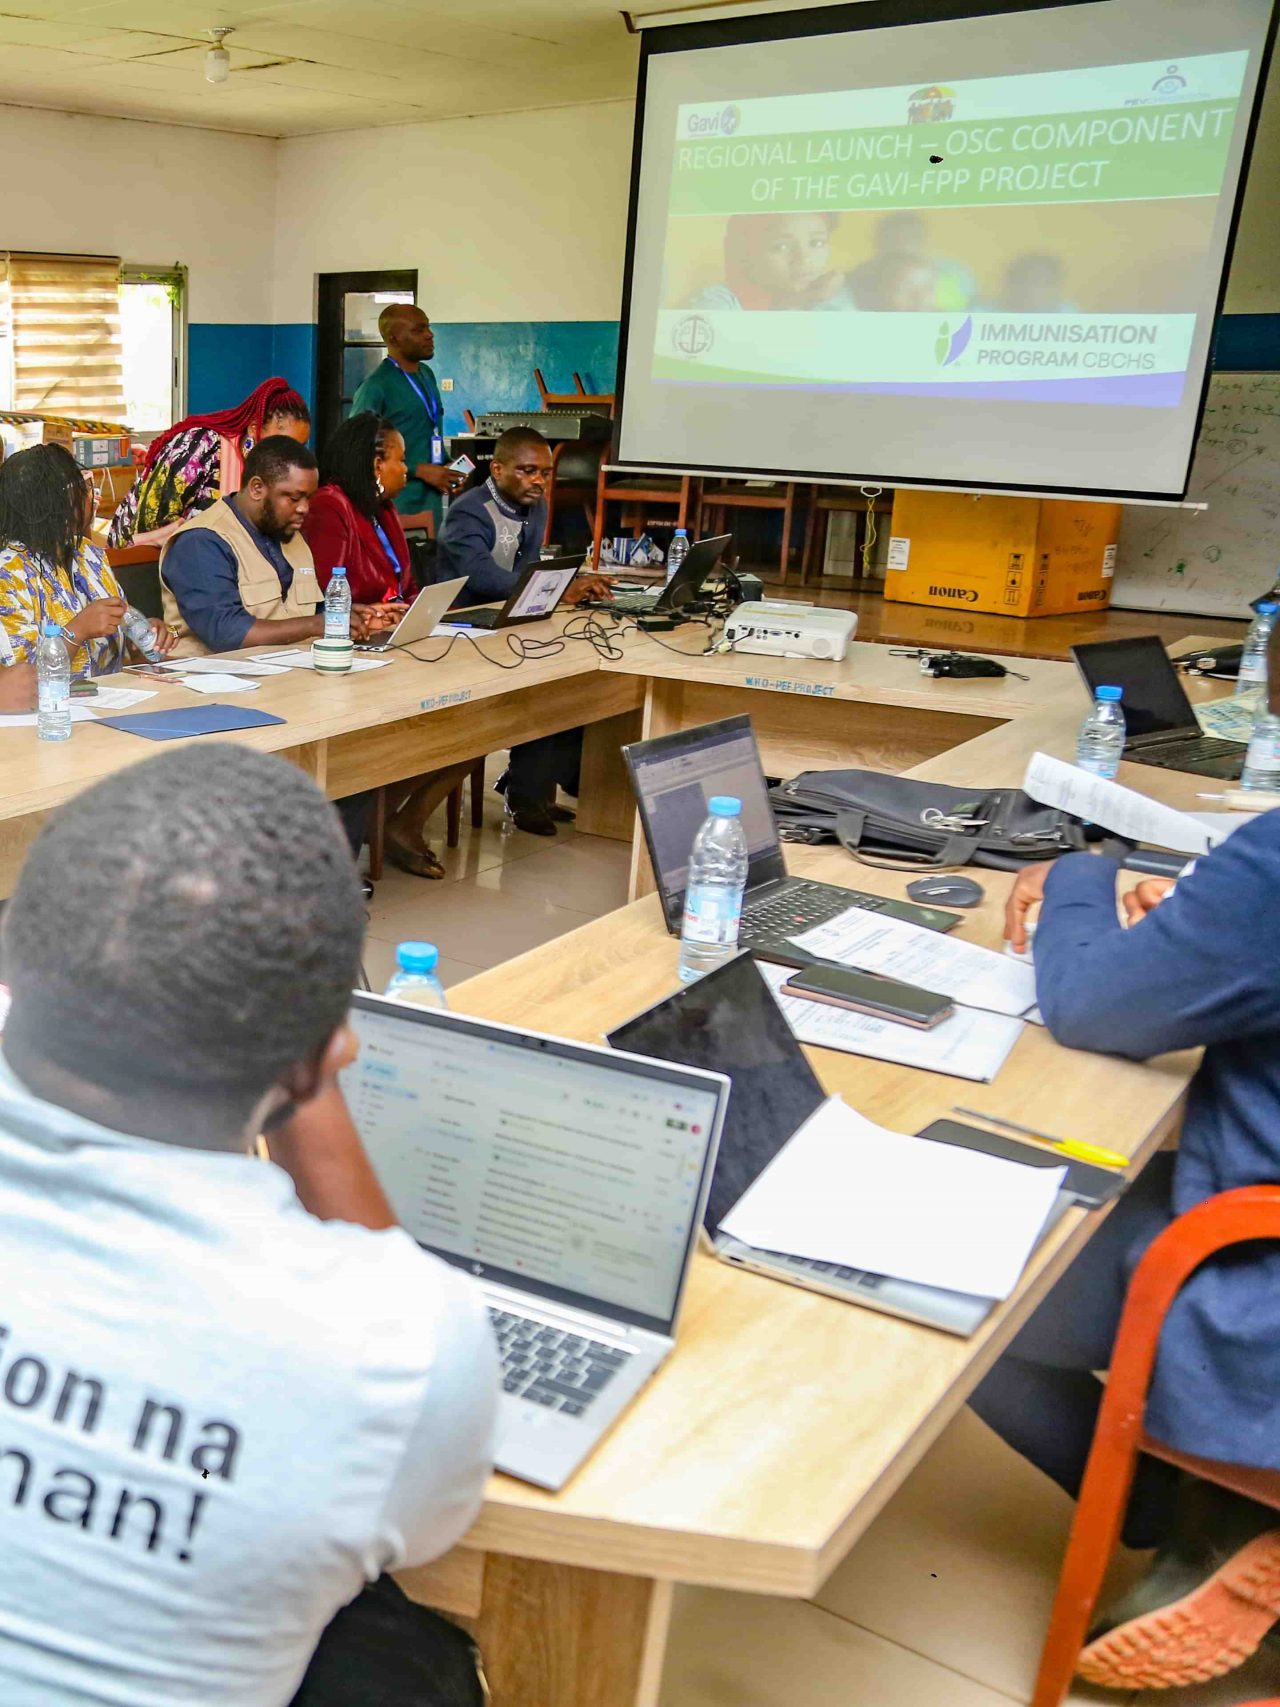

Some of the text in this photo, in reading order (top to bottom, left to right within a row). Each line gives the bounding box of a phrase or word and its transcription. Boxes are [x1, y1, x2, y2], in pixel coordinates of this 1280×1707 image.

[687, 113, 720, 134] Gavi
[678, 141, 797, 171] REGIONAL
[805, 134, 912, 164] LAUNCH
[945, 127, 1003, 156] OSC
[1011, 107, 1233, 152] COMPONENT
[751, 160, 1110, 201] OF THE GAVI-FPP PROJECT
[980, 324, 1158, 345] IMMUNISATION
[977, 350, 1156, 370] PROGRAM CBCHS
[928, 585, 979, 603] Canon
[1077, 590, 1107, 601] Canon
[132, 1396, 243, 1481] na
